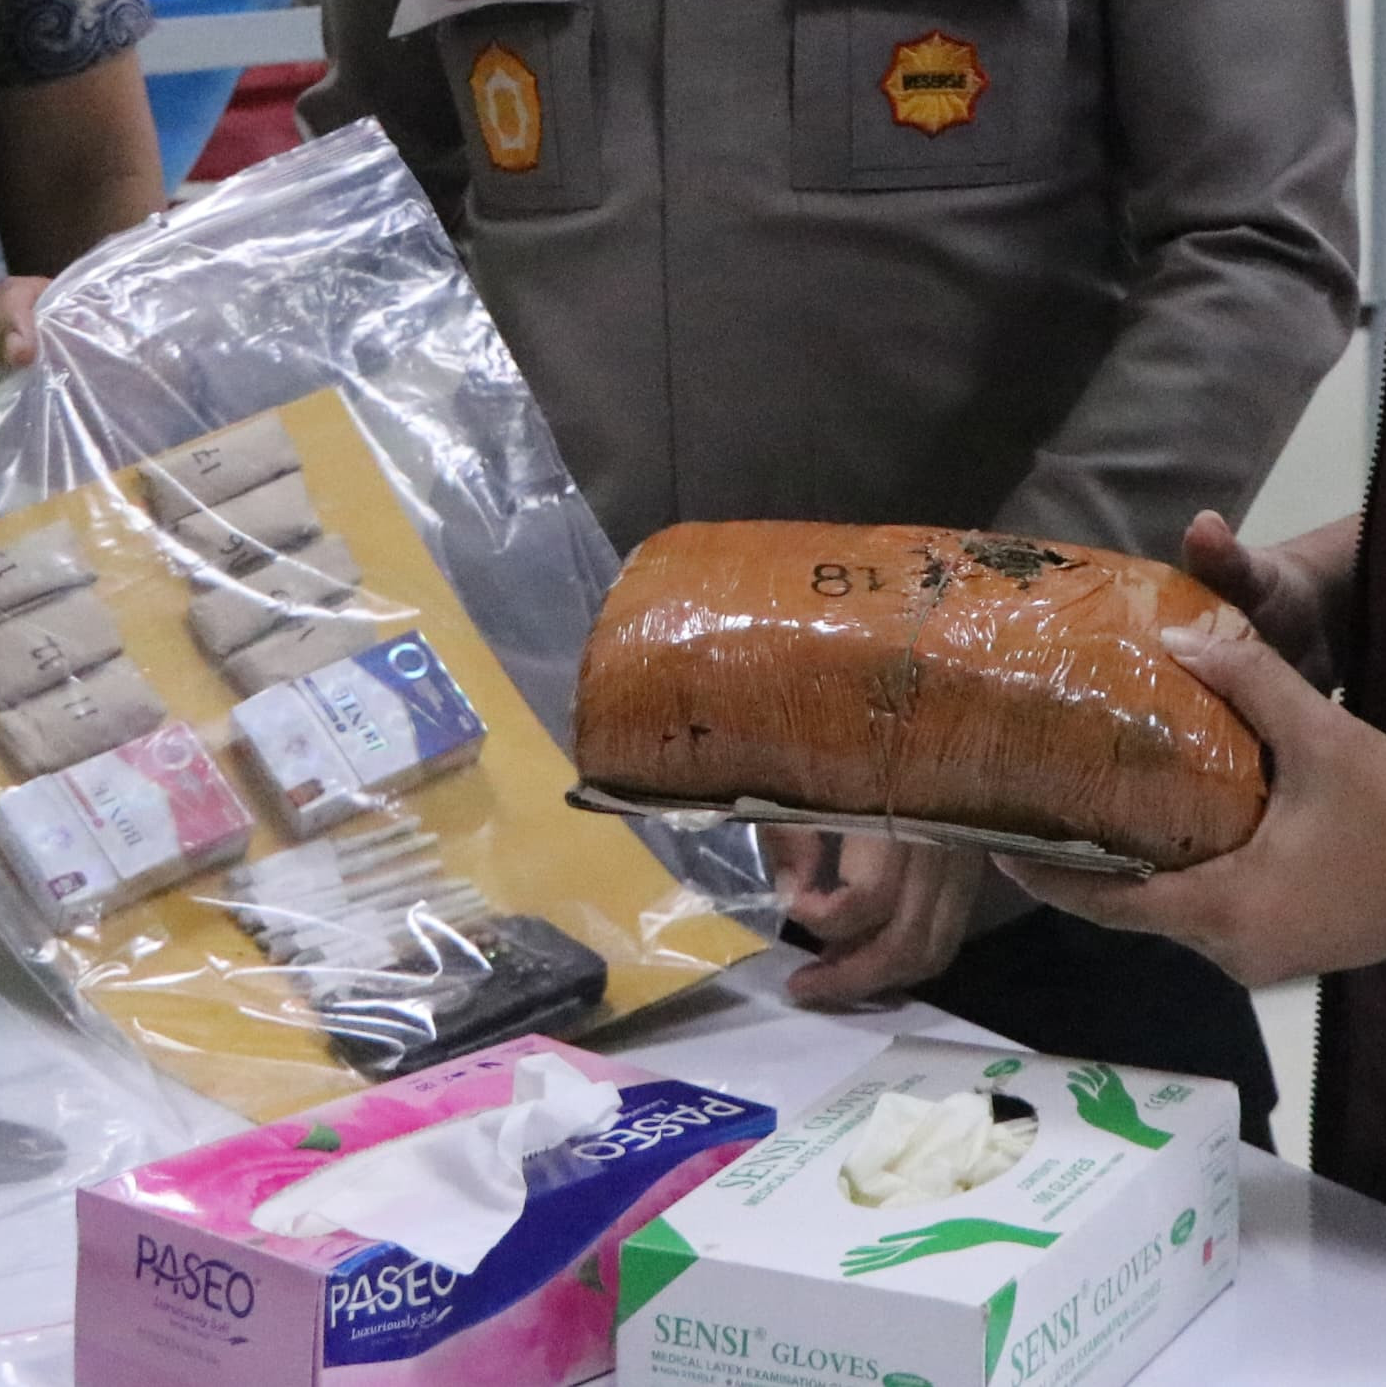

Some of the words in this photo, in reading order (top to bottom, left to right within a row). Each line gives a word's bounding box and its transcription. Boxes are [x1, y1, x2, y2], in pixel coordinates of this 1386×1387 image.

[571, 1096, 746, 1161] PASEO
[715, 1136, 809, 1190] SENSI
[135, 1233, 255, 1320] PASEO
[330, 1257, 458, 1329] PASEO
[1093, 1233, 1163, 1317] GLOVES
[351, 1315, 417, 1340] Luxuriously
[653, 1312, 751, 1359] SENSI
[771, 1341, 881, 1381] GLOVES
[651, 1349, 702, 1369] MEDICAL
[705, 1359, 743, 1376] LATEX
